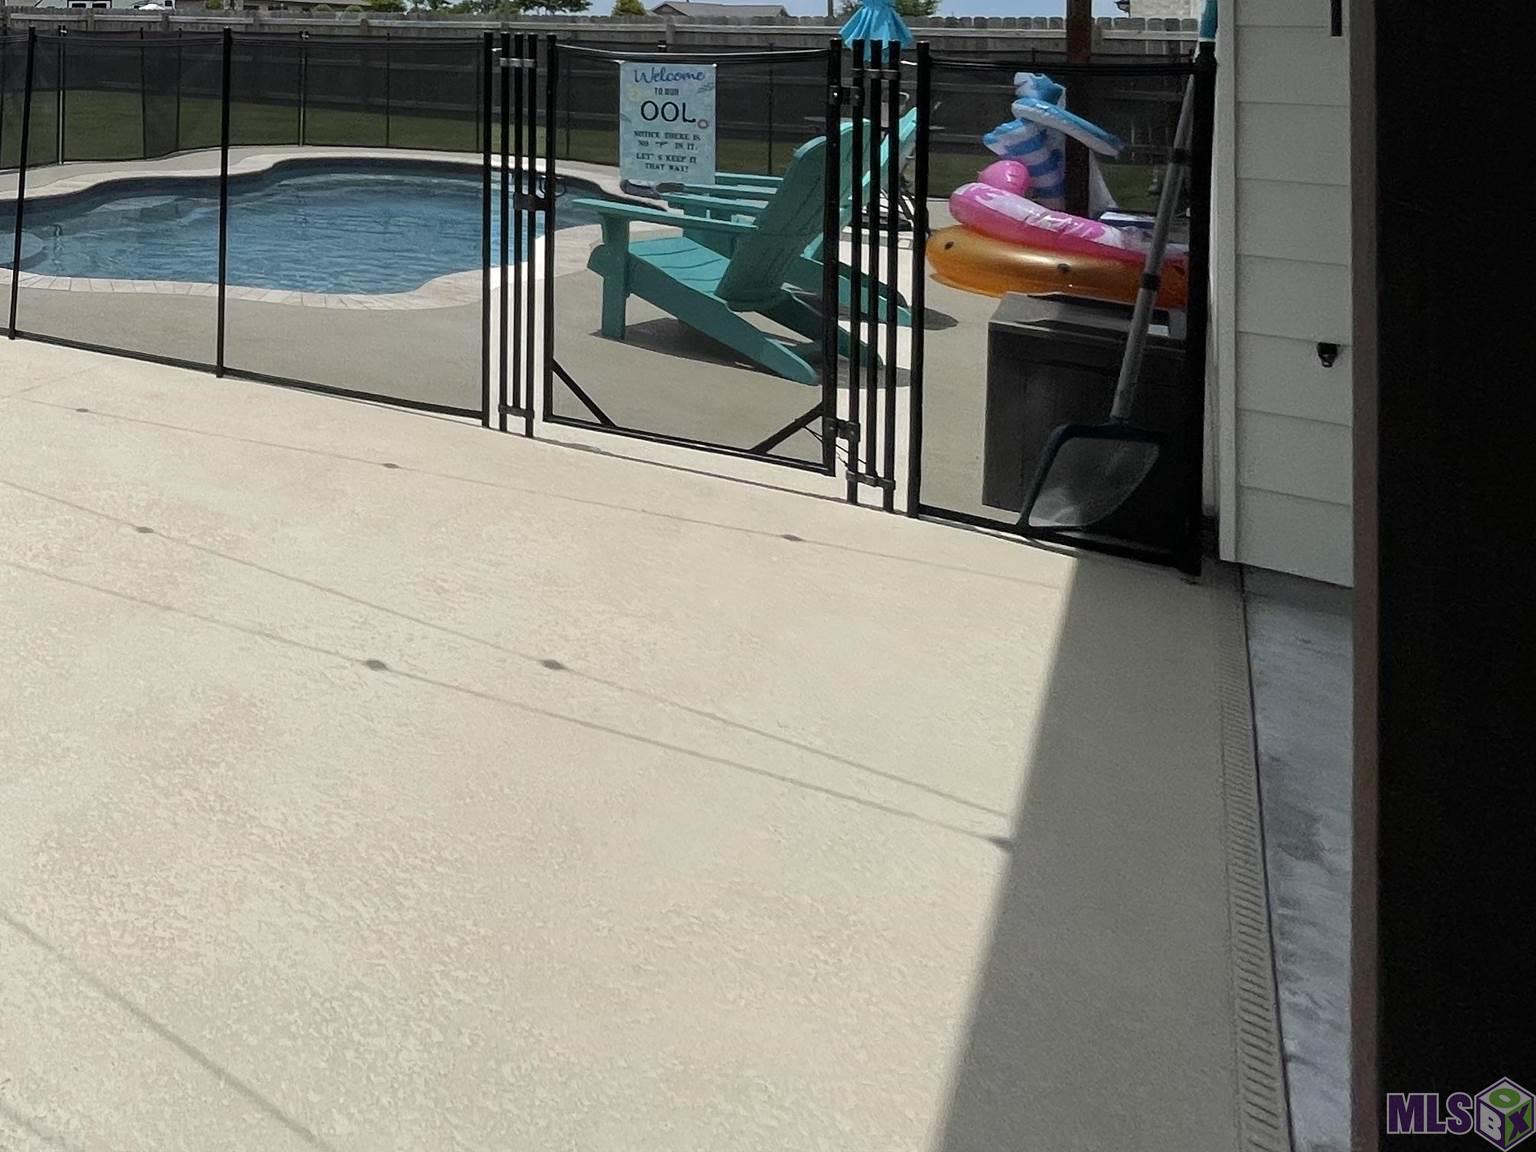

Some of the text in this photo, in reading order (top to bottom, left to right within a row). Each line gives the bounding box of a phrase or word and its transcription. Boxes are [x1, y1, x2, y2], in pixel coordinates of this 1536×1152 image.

[634, 67, 704, 84] Welcome
[654, 87, 663, 96] TO
[641, 100, 696, 123] OOL
